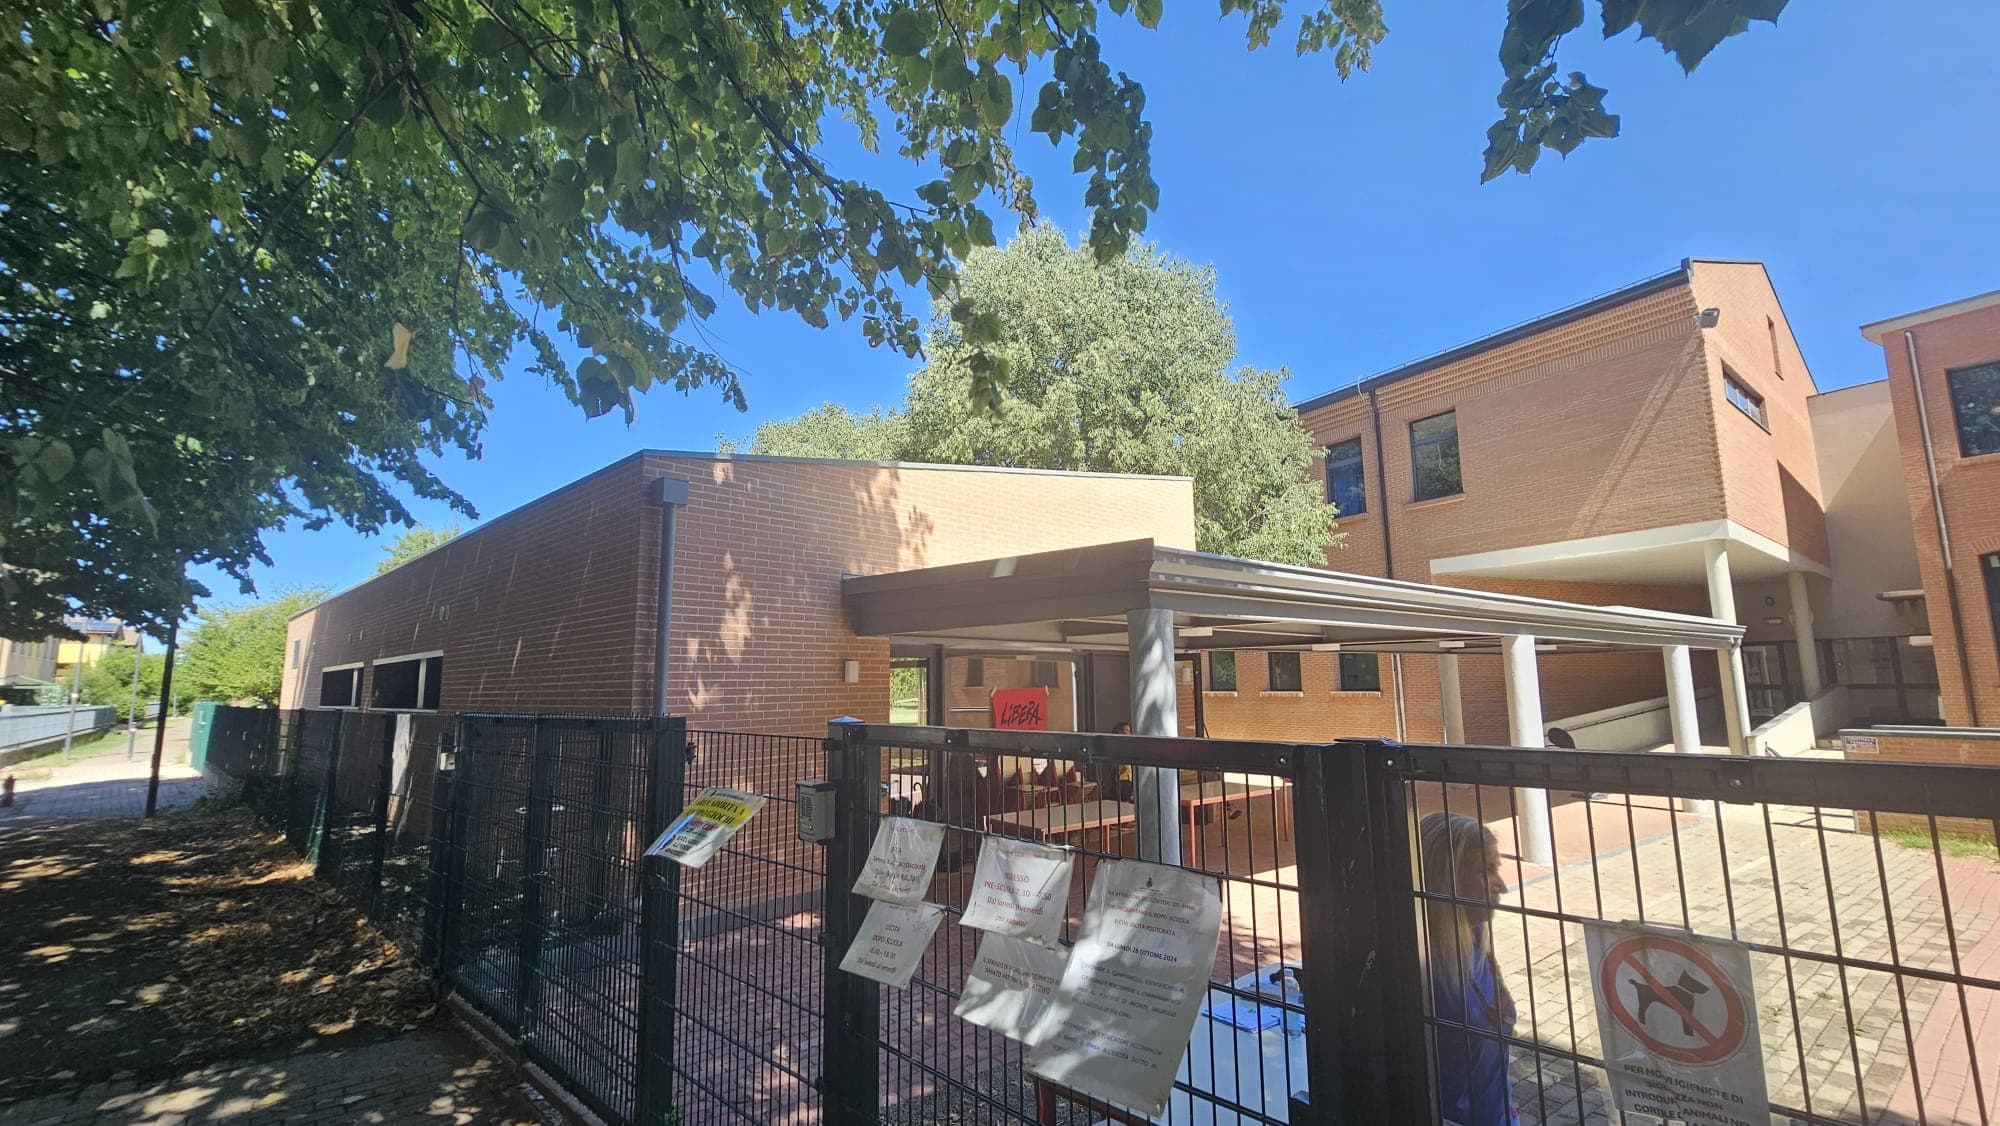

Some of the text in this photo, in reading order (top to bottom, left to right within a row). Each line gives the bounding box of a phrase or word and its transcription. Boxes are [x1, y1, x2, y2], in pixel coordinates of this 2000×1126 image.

[1000, 700, 1042, 726] LIBERA
[1132, 946, 1139, 954] 28
[1139, 948, 1163, 960] OTTOBRE
[1163, 953, 1178, 962] 2024
[1624, 1064, 1645, 1076] PER
[1721, 1090, 1730, 1101] E
[1731, 1093, 1745, 1105] DI
[1633, 1103, 1678, 1120] CORTILE
[1697, 1098, 1724, 1111] NON
[1682, 1107, 1729, 1124] ANIMALI
